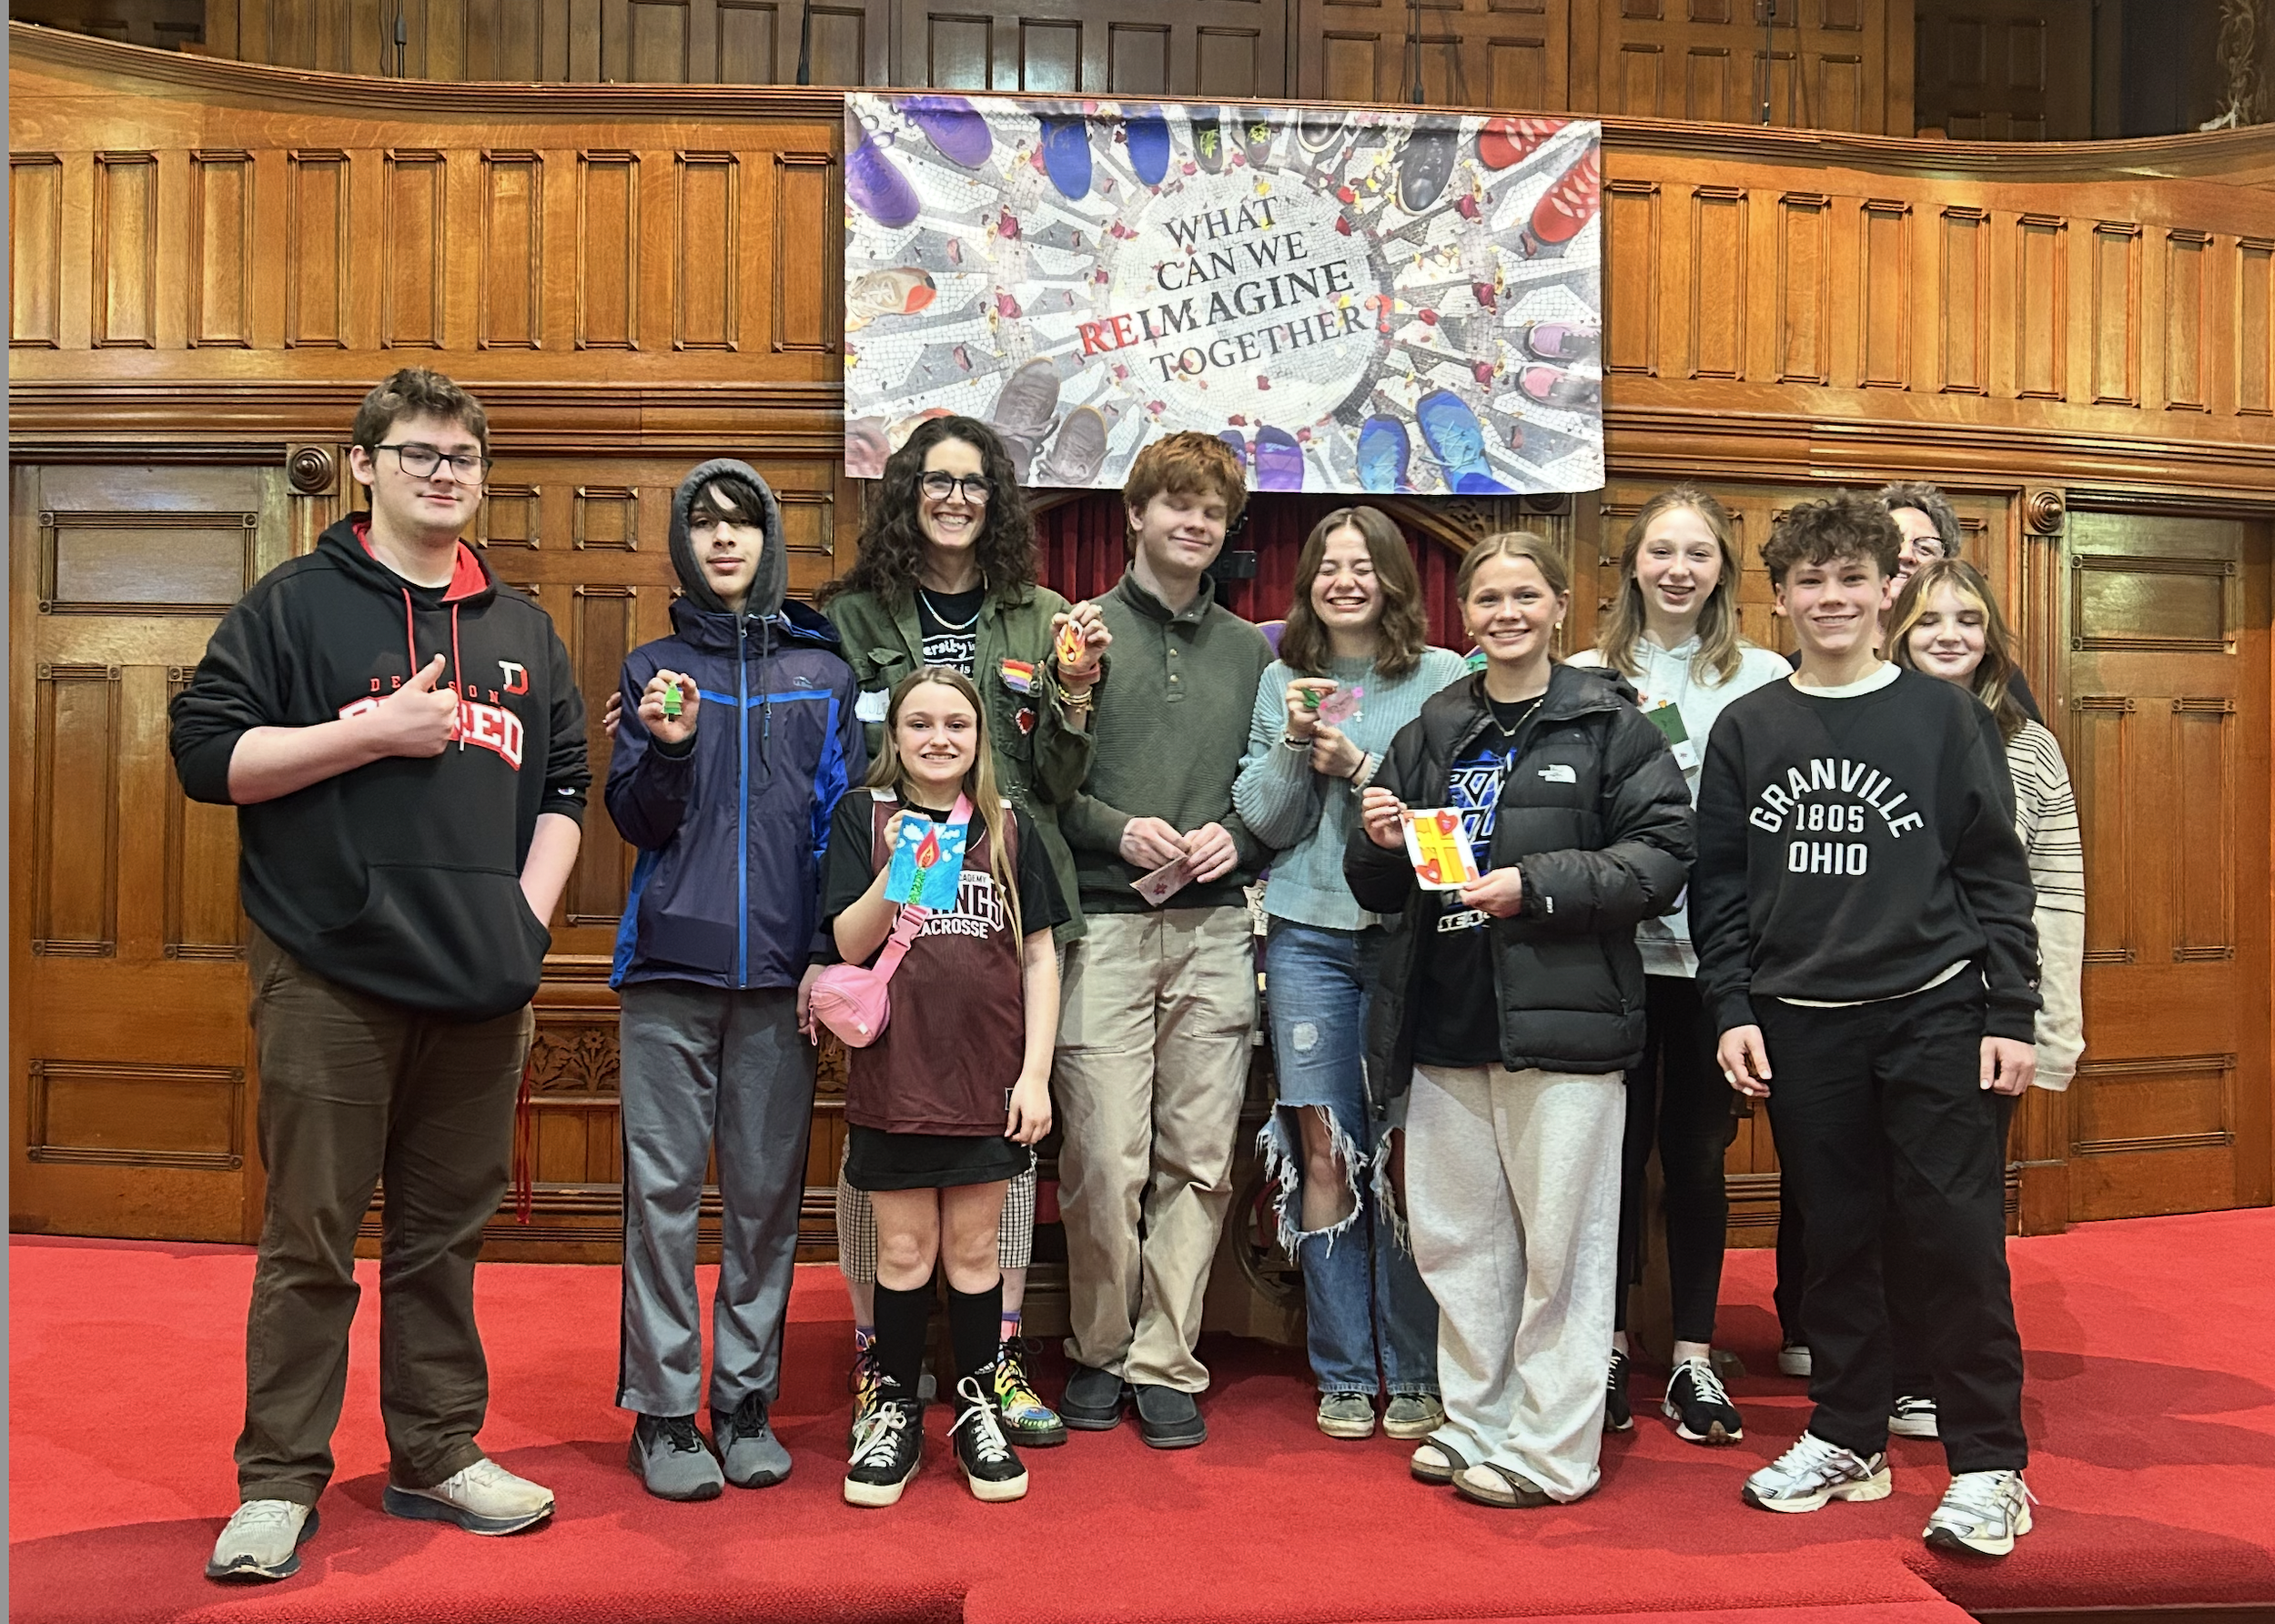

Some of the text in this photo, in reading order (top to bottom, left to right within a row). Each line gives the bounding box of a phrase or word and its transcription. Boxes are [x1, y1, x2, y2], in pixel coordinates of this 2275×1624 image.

[1162, 197, 1278, 247] WHAT
[1157, 230, 1308, 291] CAN WE
[1076, 259, 1355, 358] REIMAGINE
[369, 675, 500, 705] DESON
[499, 660, 530, 695] D
[1749, 758, 1925, 839] GRANVILLE
[1795, 803, 1865, 833] 1805
[1788, 841, 1868, 876] OHIO
